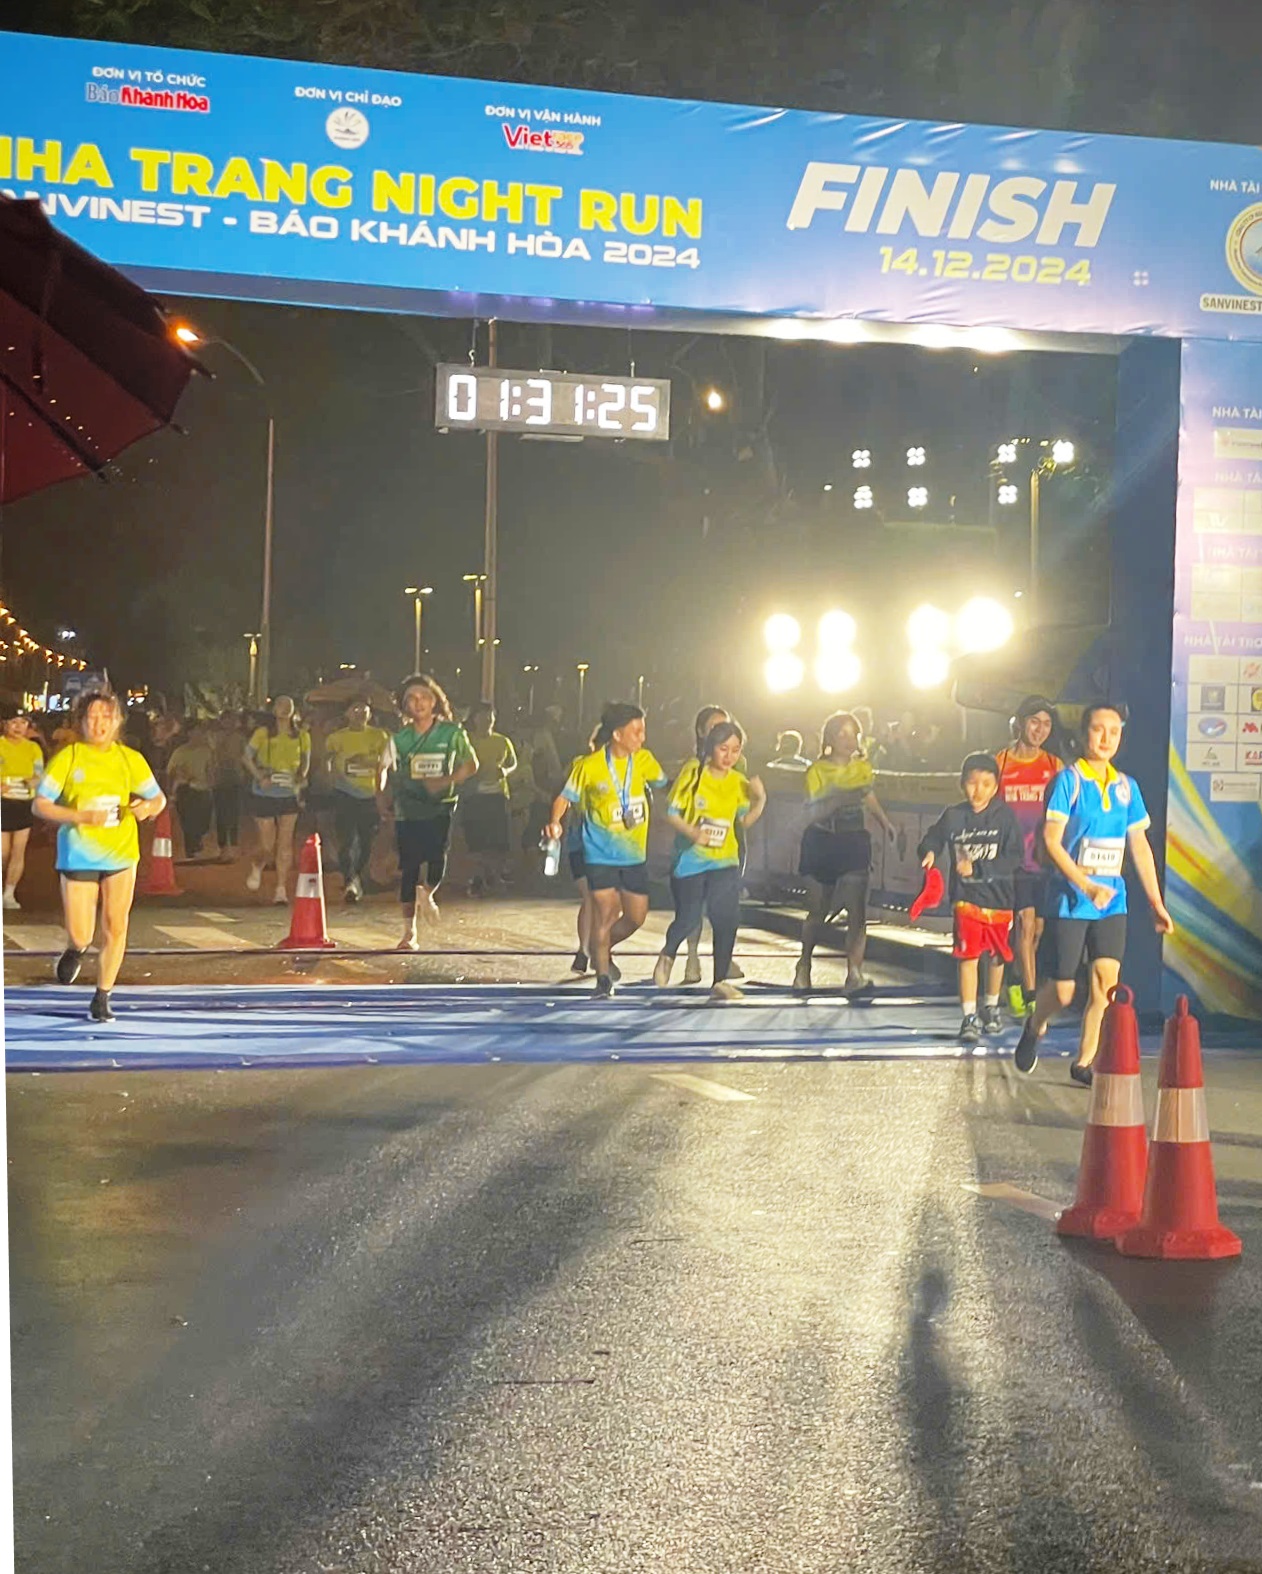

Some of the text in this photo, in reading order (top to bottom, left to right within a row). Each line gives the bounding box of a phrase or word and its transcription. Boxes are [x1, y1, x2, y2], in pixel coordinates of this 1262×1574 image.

[294, 86, 326, 99] ĐƠN
[485, 104, 516, 119] ĐƠN
[564, 111, 602, 127] HÀNH
[0, 135, 702, 239] HA TRANG NIGHT RUN
[1210, 179, 1238, 192] NHÀ
[1241, 180, 1260, 194] TÀI
[786, 161, 1117, 248] FINISH
[250, 209, 339, 239] BÁO
[351, 218, 496, 253] KHÁNH
[508, 231, 591, 261] HÒA
[603, 241, 700, 269] 2024
[879, 246, 1092, 287] 14.12.2024
[1202, 296, 1262, 312] SANVINEST
[1212, 405, 1241, 418] NHÀ
[1243, 406, 1262, 420] TÀI
